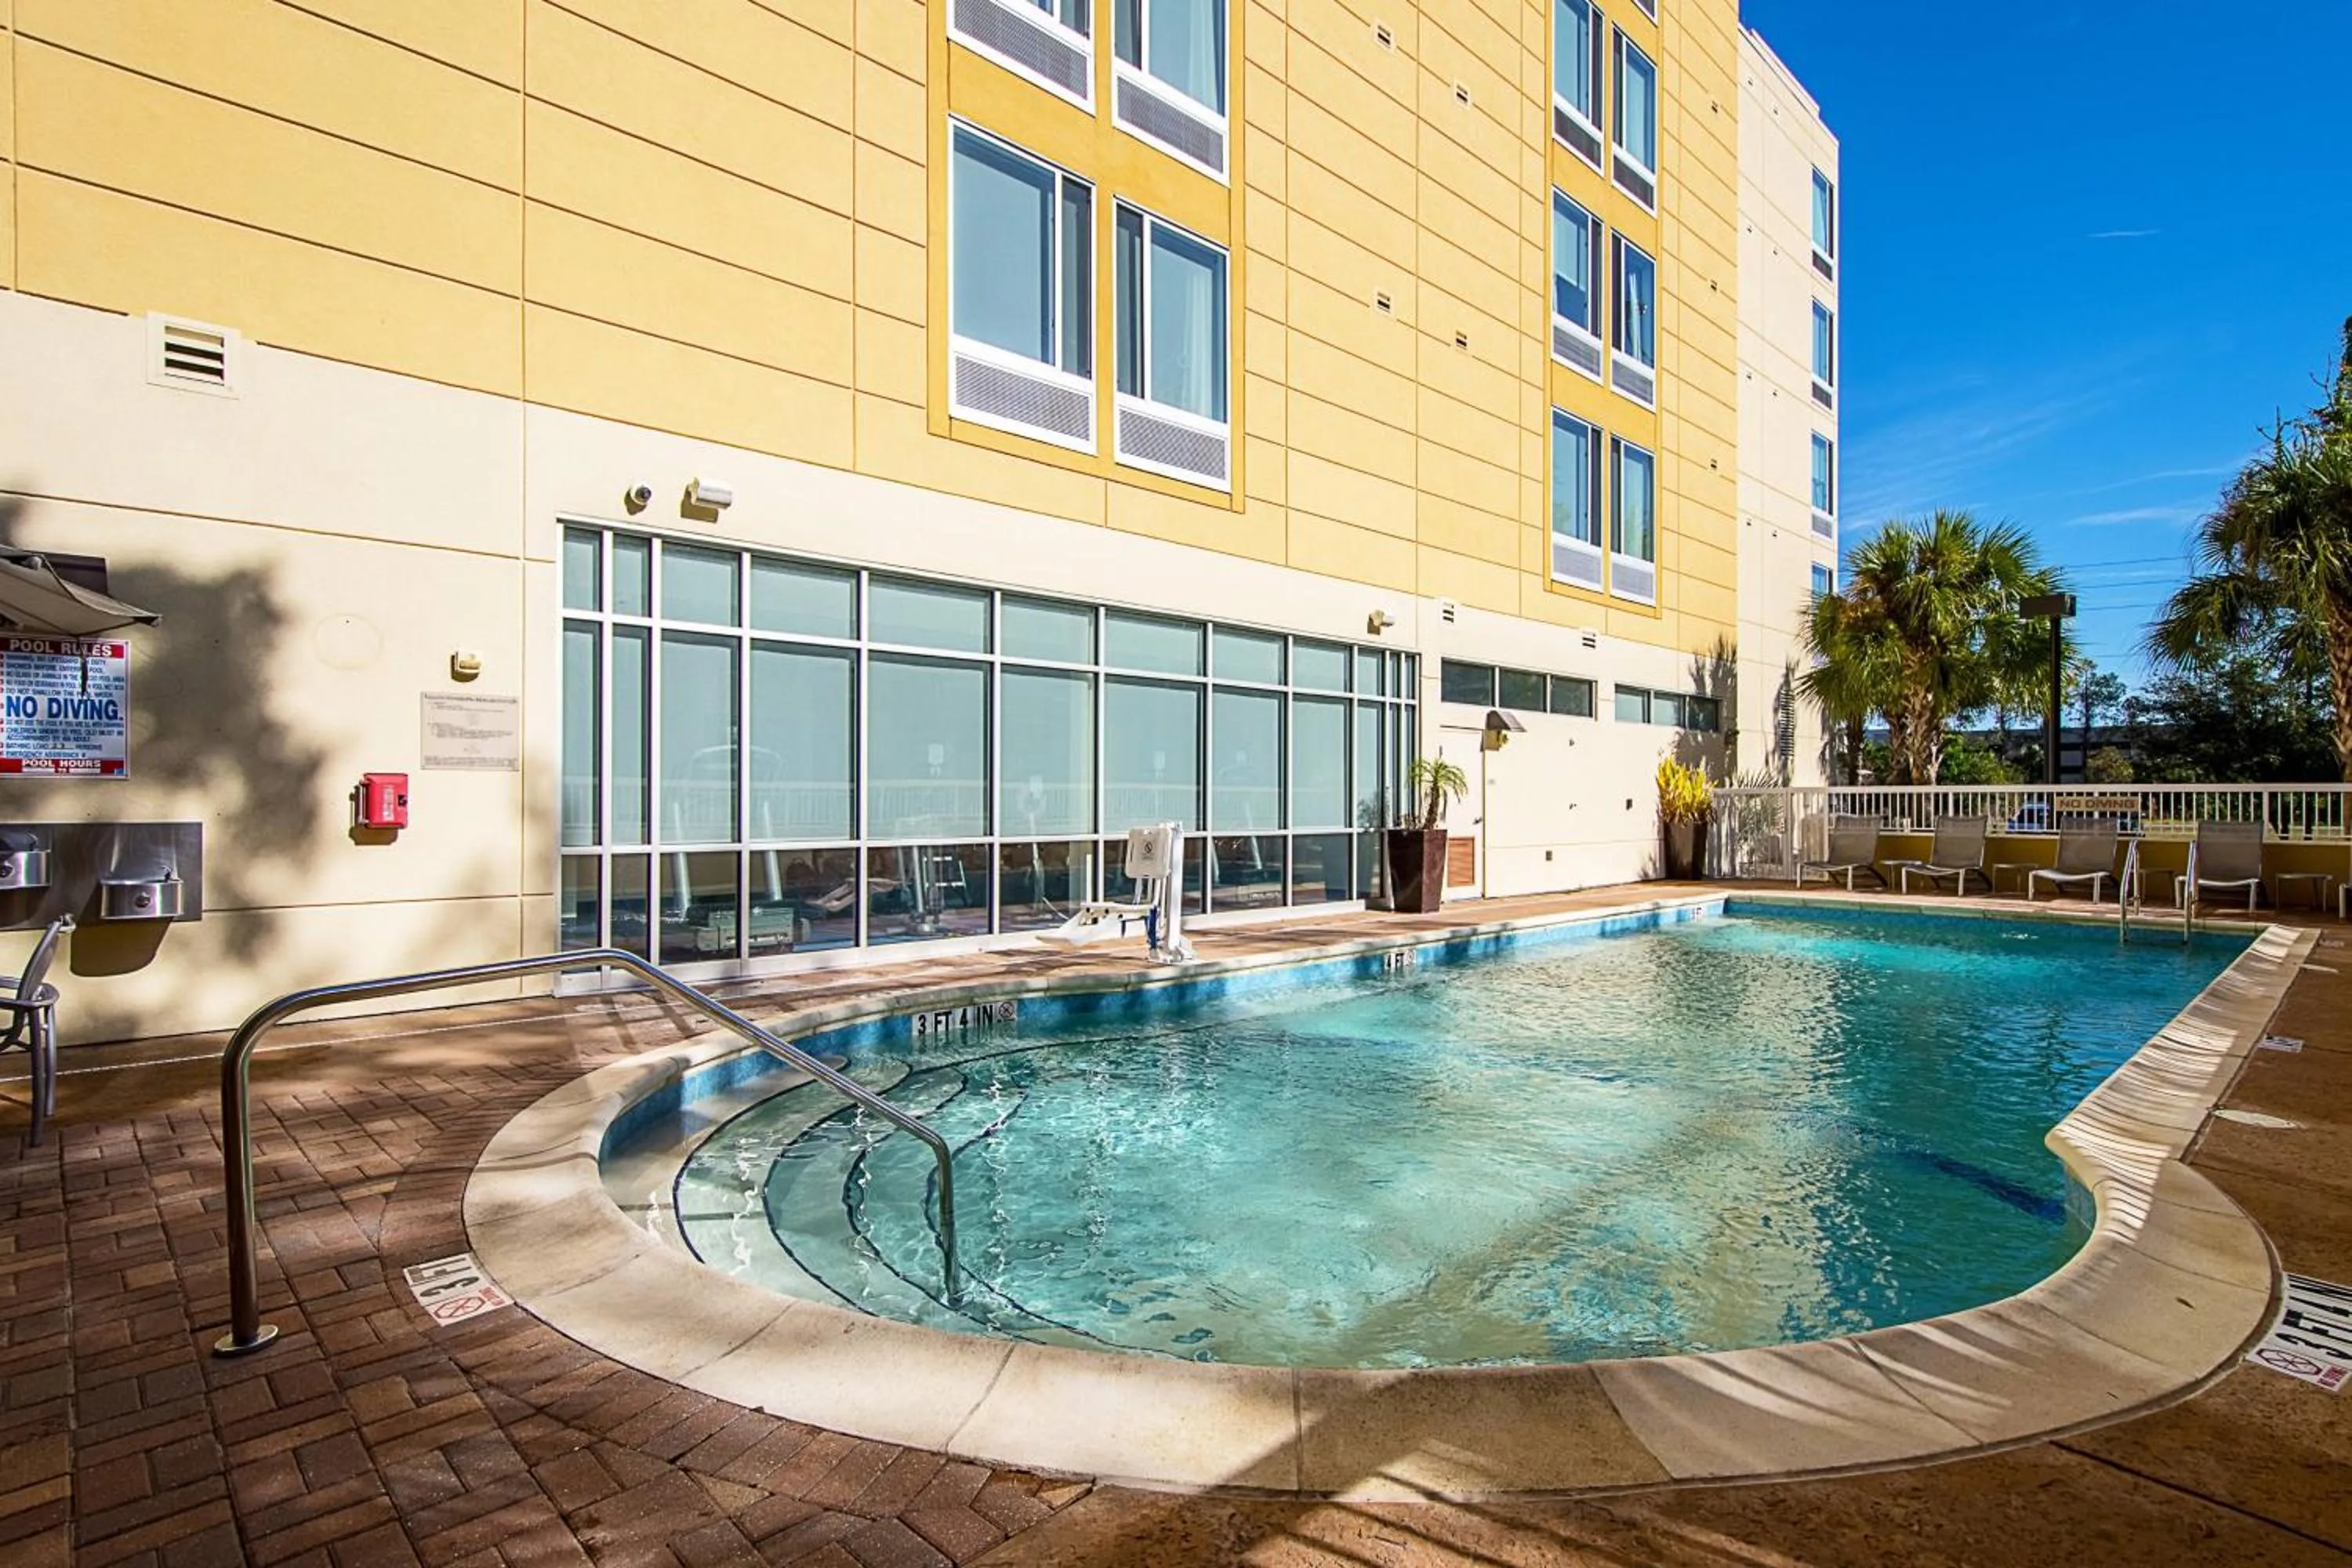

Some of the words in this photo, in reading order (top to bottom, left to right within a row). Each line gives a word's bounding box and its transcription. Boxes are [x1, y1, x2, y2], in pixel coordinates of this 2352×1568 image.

[10, 639, 55, 653] POOL
[61, 643, 112, 656] RULES
[6, 696, 38, 717] NO
[48, 698, 124, 720] DIVING.
[2060, 799, 2081, 808] NO
[2085, 799, 2135, 809] DIVING
[917, 1014, 927, 1035] 3
[934, 1011, 952, 1033] FT
[959, 1007, 968, 1028] 4
[976, 1004, 993, 1026] IN
